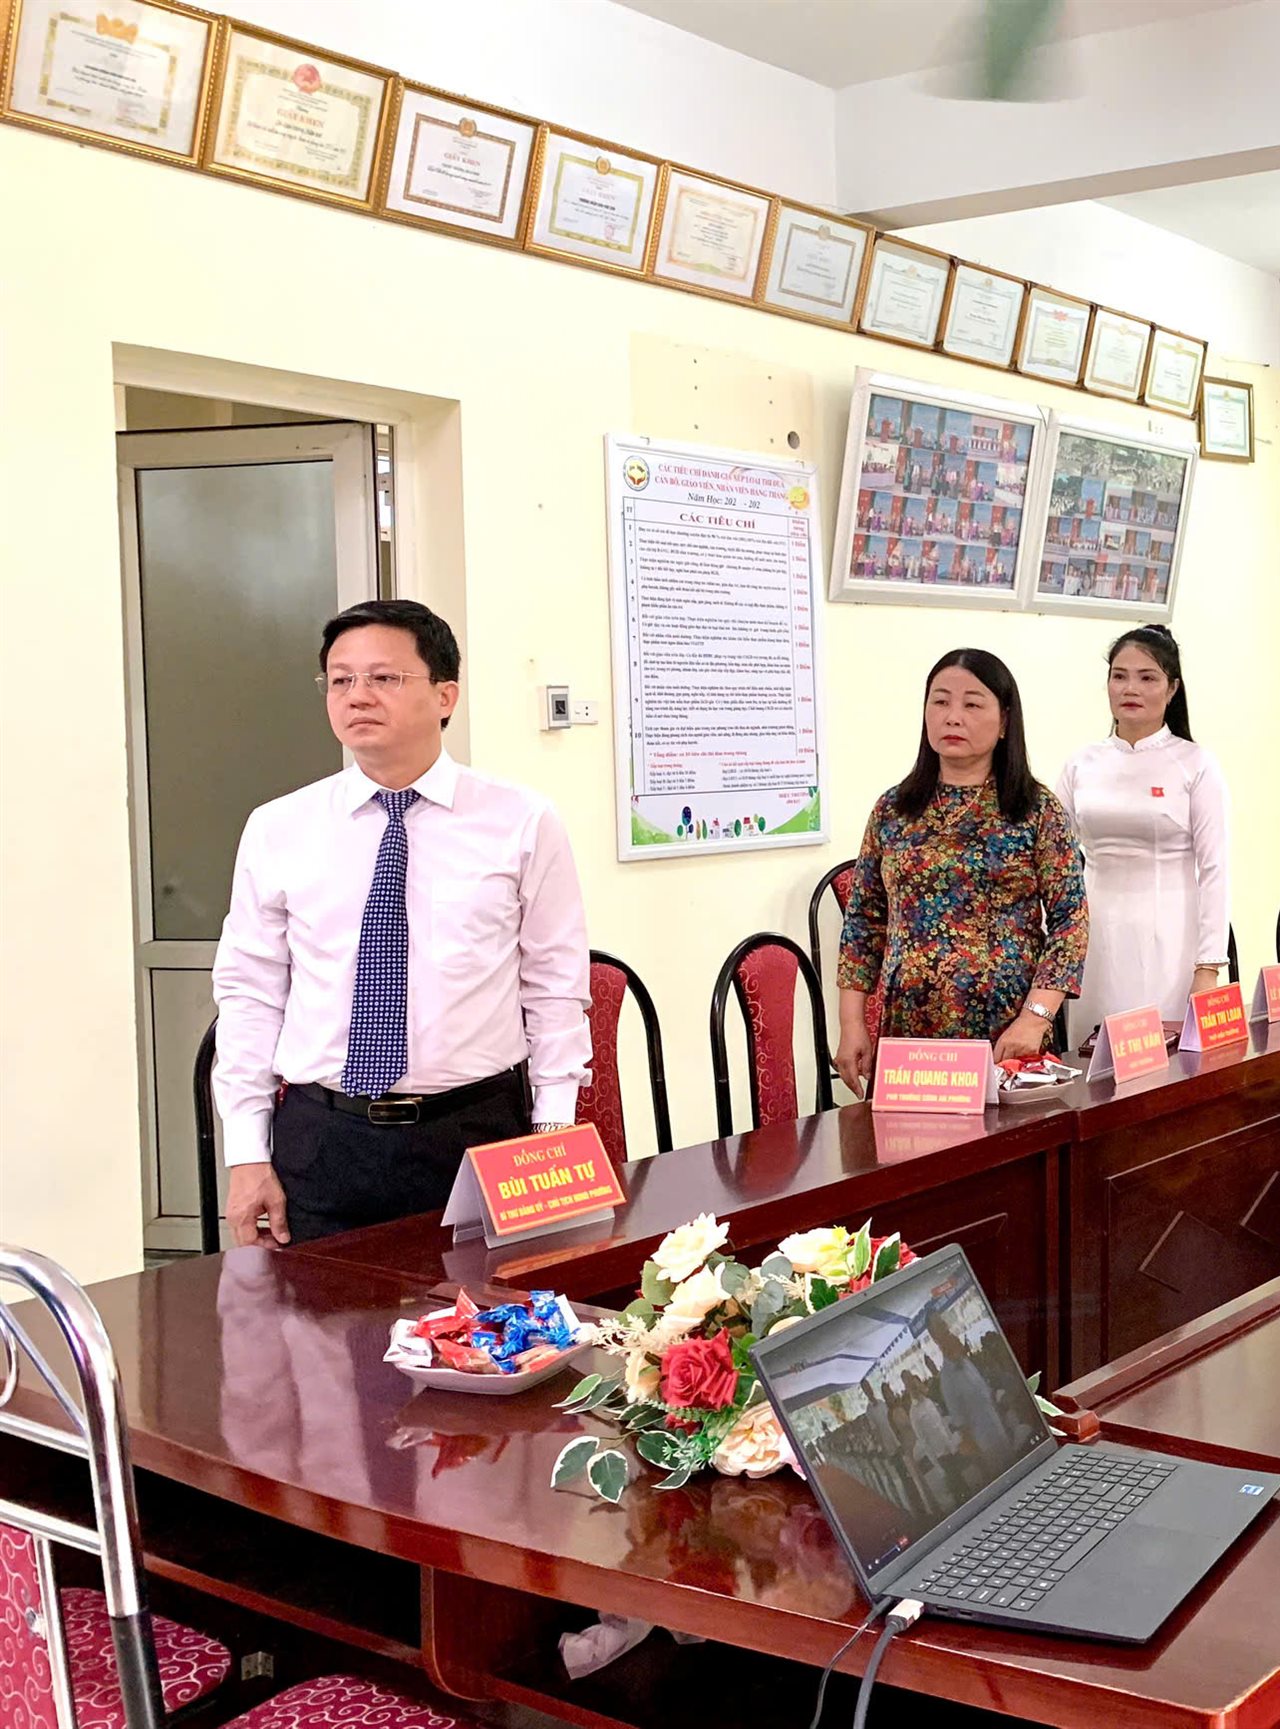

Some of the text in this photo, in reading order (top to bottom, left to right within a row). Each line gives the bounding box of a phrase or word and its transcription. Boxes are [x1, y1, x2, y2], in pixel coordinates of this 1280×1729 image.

[680, 512, 756, 529] CÁC TIÊU CHÍ
[909, 1047, 937, 1062] ĐỒNG
[1114, 1040, 1126, 1057] LÊ
[1128, 1037, 1142, 1053] THỊ
[884, 1064, 978, 1088] TRẦN QUANG KHOA
[513, 1142, 567, 1167] ĐỒNG CHÍ
[498, 1160, 596, 1200] BÙI TUẤN TỰ
